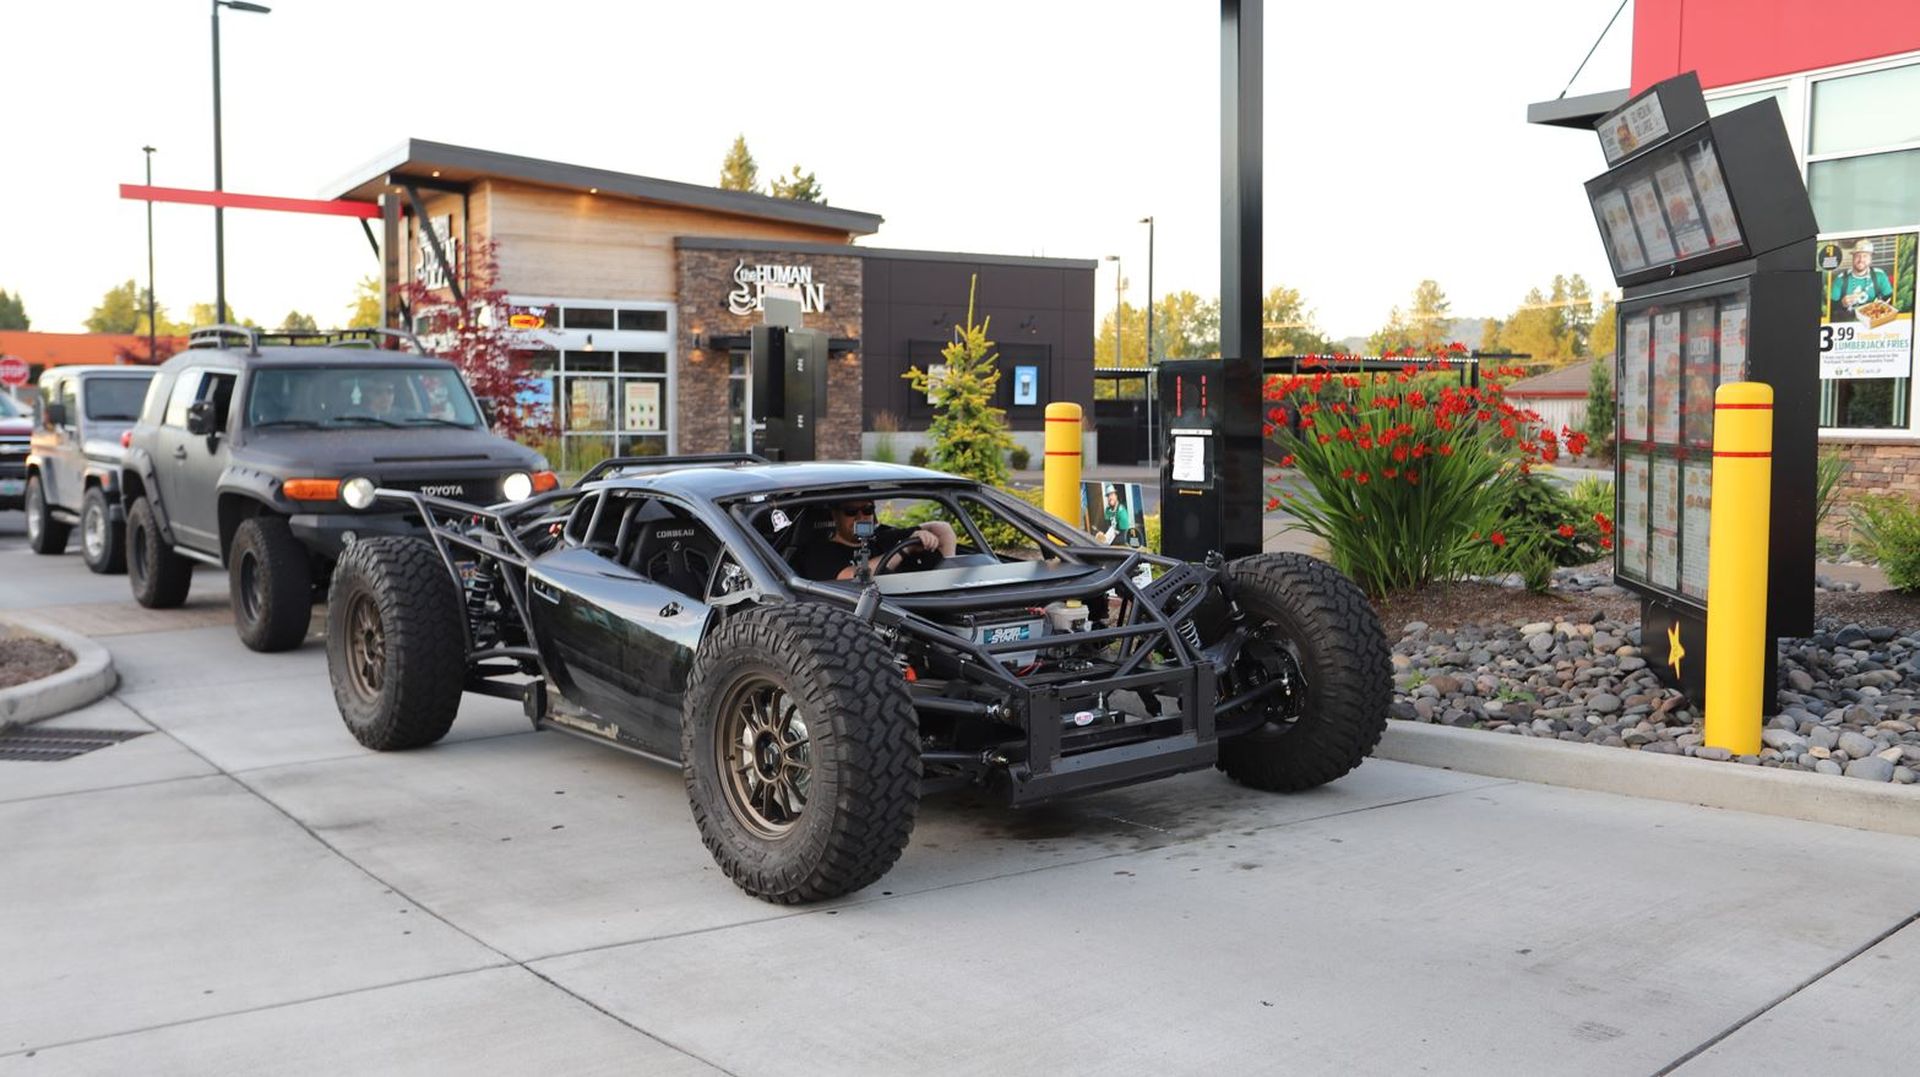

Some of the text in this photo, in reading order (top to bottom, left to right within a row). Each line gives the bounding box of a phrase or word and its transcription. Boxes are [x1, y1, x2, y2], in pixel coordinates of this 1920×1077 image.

[756, 265, 812, 284] HUMAN
[1834, 338, 1909, 351] LUMBERJACK FRIES
[0, 364, 28, 377] STOP
[421, 485, 463, 496] TOYOTA
[656, 529, 694, 538] CORBEAU
[994, 627, 1021, 637] SUPER
